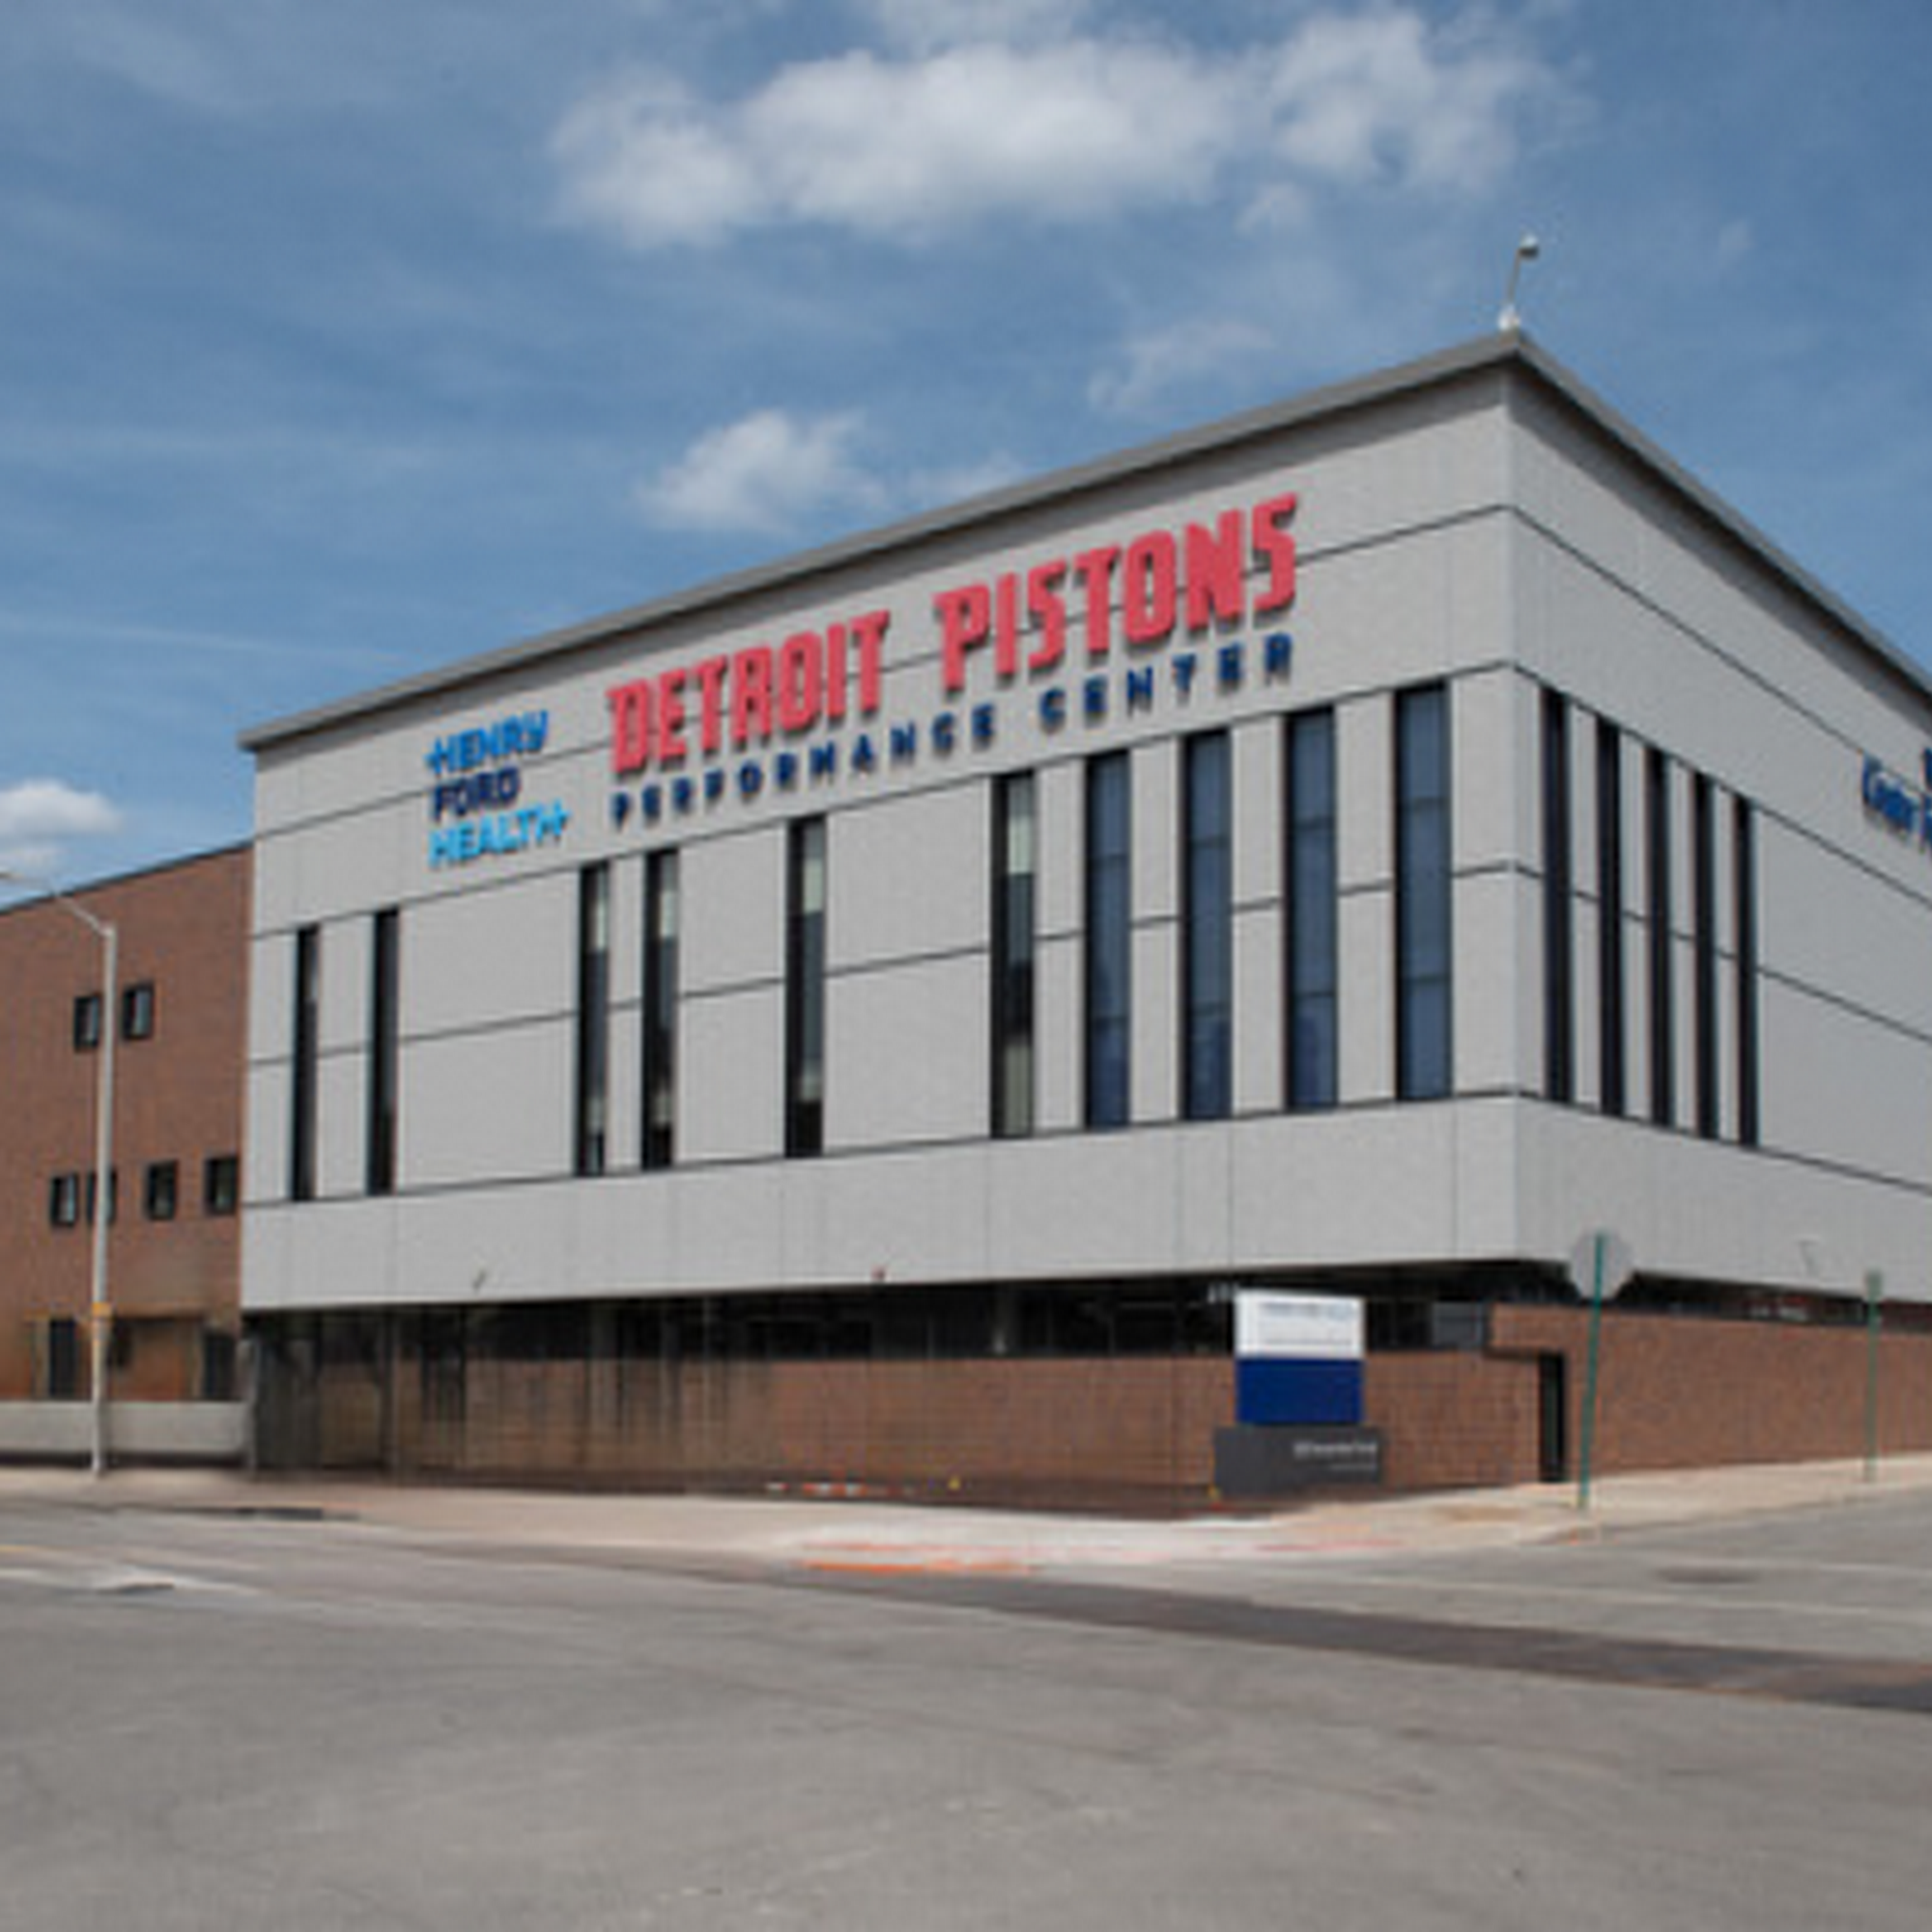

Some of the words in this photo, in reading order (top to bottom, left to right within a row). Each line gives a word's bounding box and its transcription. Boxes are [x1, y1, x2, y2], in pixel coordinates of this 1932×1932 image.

[606, 608, 890, 775] DETROIT
[931, 492, 1297, 692] PISTONS
[423, 709, 550, 776] HENRY
[611, 702, 994, 823] PERFORMANCE
[1039, 633, 1293, 724] CENTER
[430, 765, 522, 821] FORD
